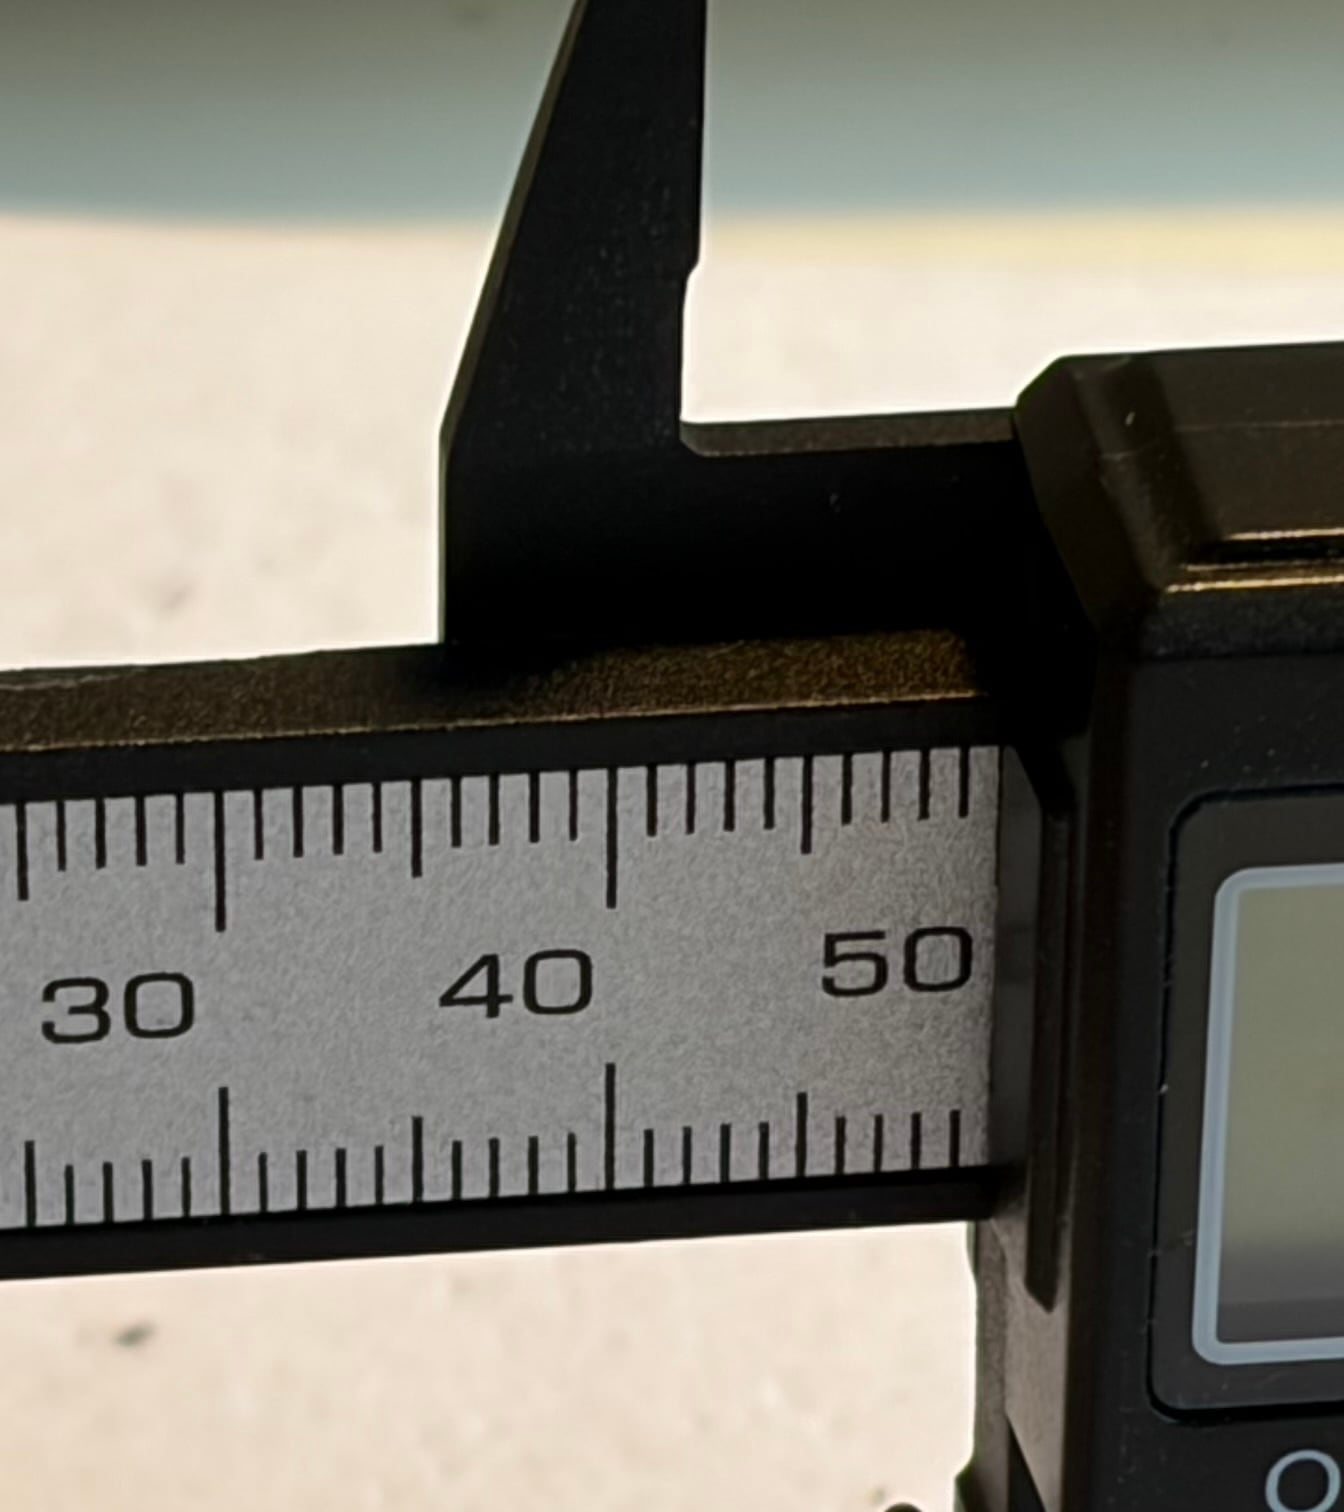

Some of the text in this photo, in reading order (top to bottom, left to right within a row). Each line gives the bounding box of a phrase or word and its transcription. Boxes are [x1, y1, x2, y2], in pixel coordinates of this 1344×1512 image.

[40, 971, 197, 1045] 30
[436, 948, 595, 1019] 40
[819, 925, 976, 998] 50
